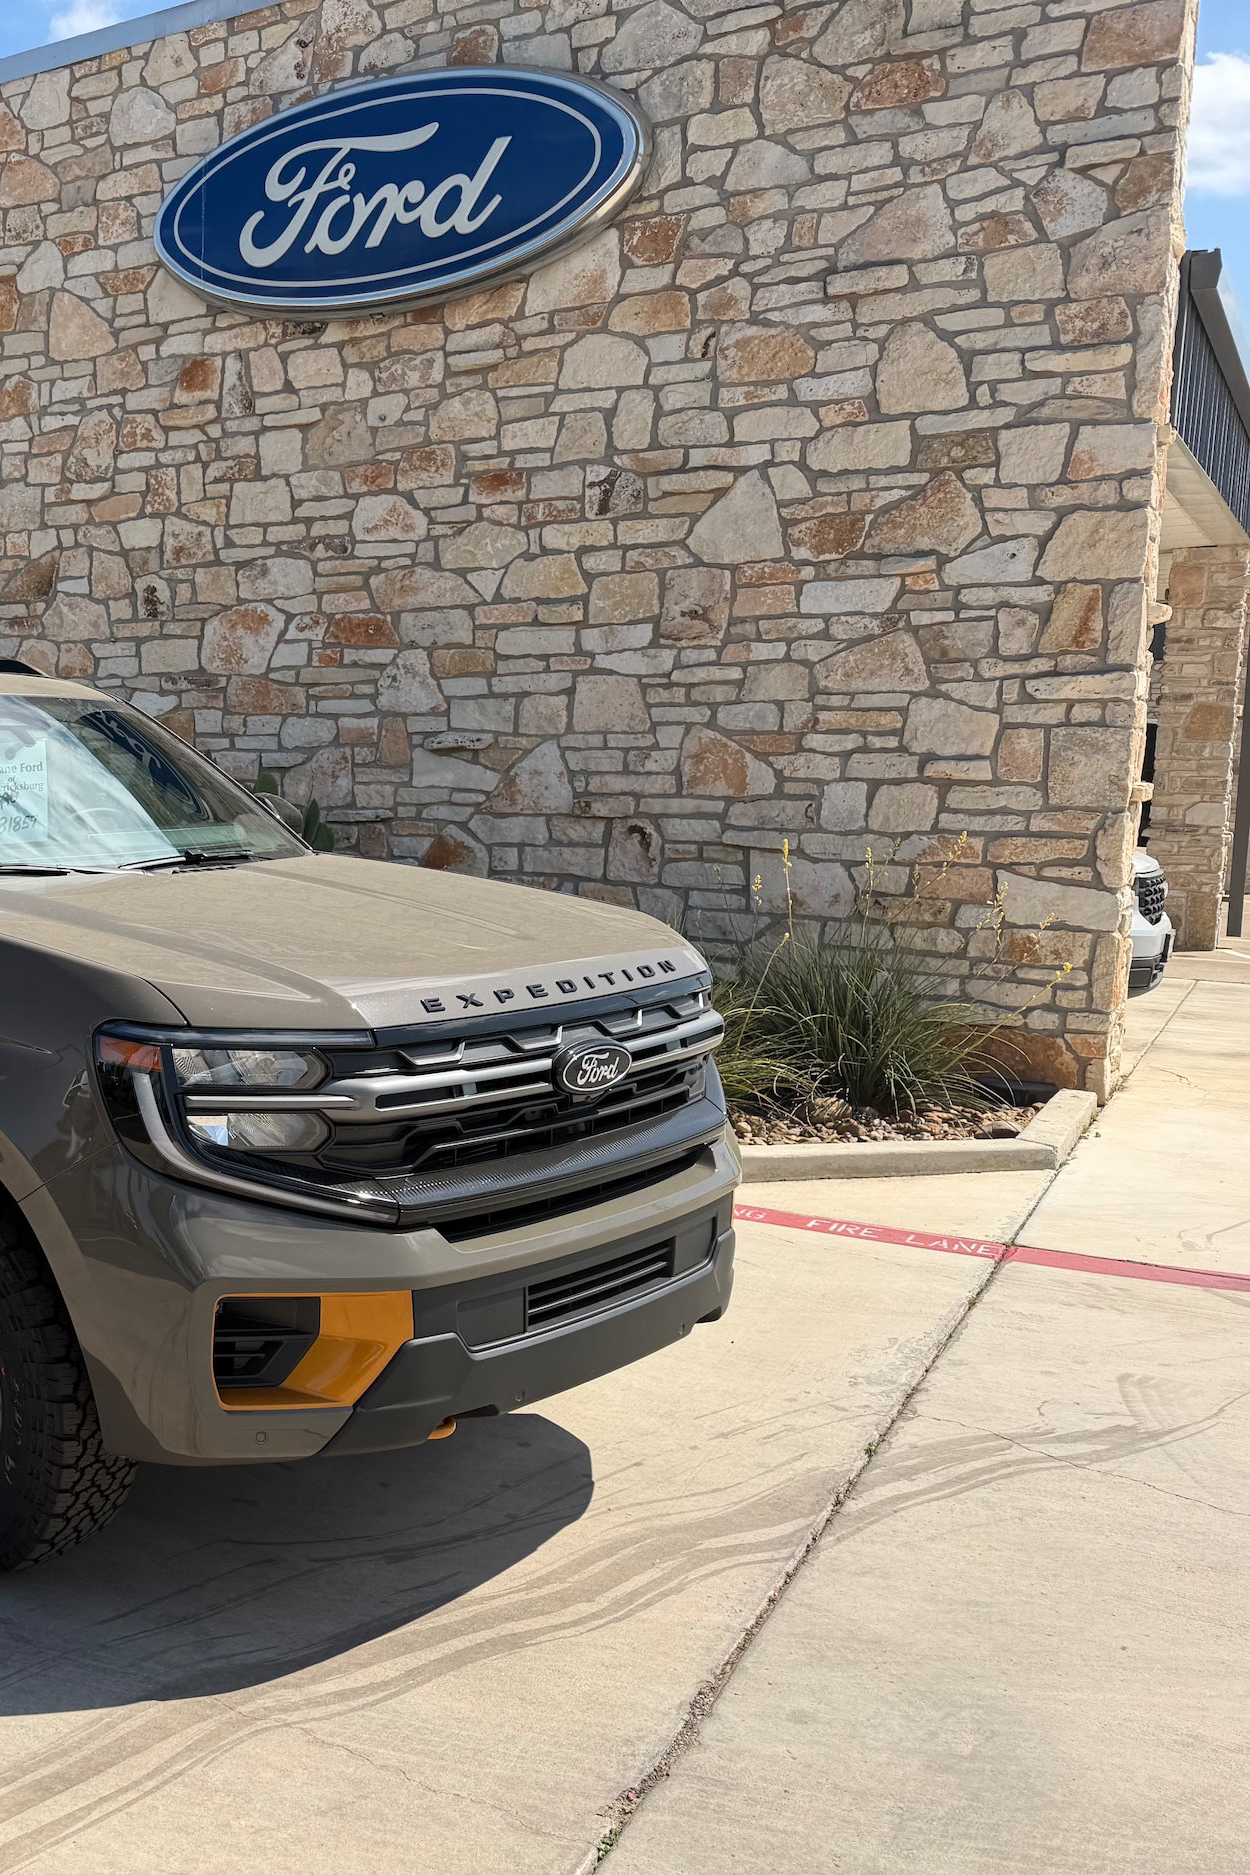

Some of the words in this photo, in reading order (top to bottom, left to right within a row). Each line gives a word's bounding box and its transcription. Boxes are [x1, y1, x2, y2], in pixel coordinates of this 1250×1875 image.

[239, 121, 512, 268] Ford
[8, 775, 16, 783] of
[20, 761, 43, 773] Ford
[419, 959, 677, 1014] EXPEDITION
[577, 1051, 620, 1086] Ford
[806, 1219, 884, 1239] FIRE
[905, 1234, 1001, 1256] LANE
